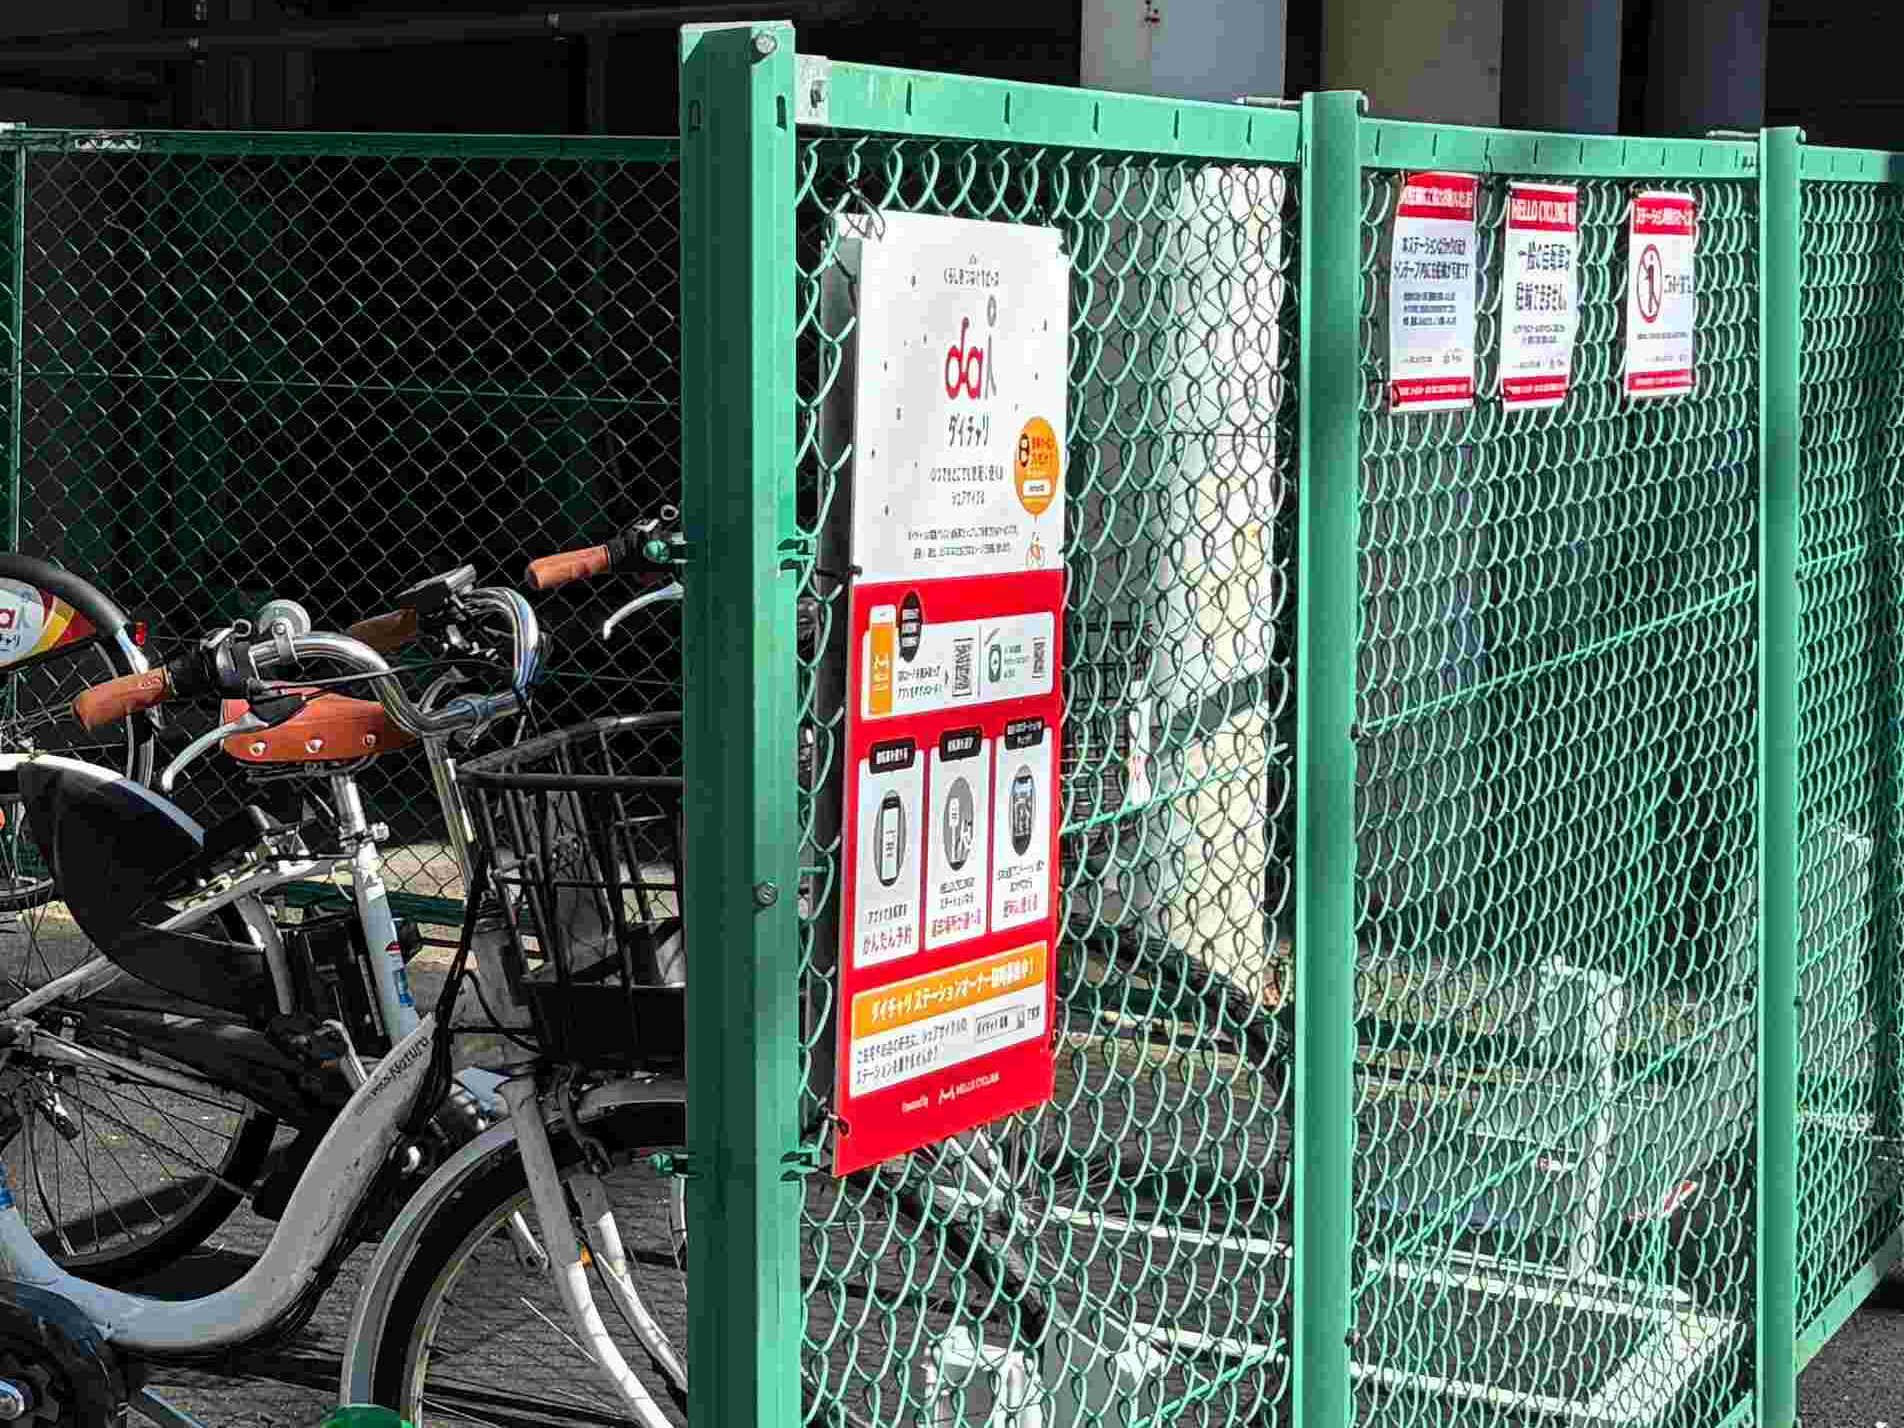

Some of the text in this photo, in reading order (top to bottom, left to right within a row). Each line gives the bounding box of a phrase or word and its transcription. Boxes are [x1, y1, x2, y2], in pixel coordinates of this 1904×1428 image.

[949, 414, 990, 448] ダイチャリ
